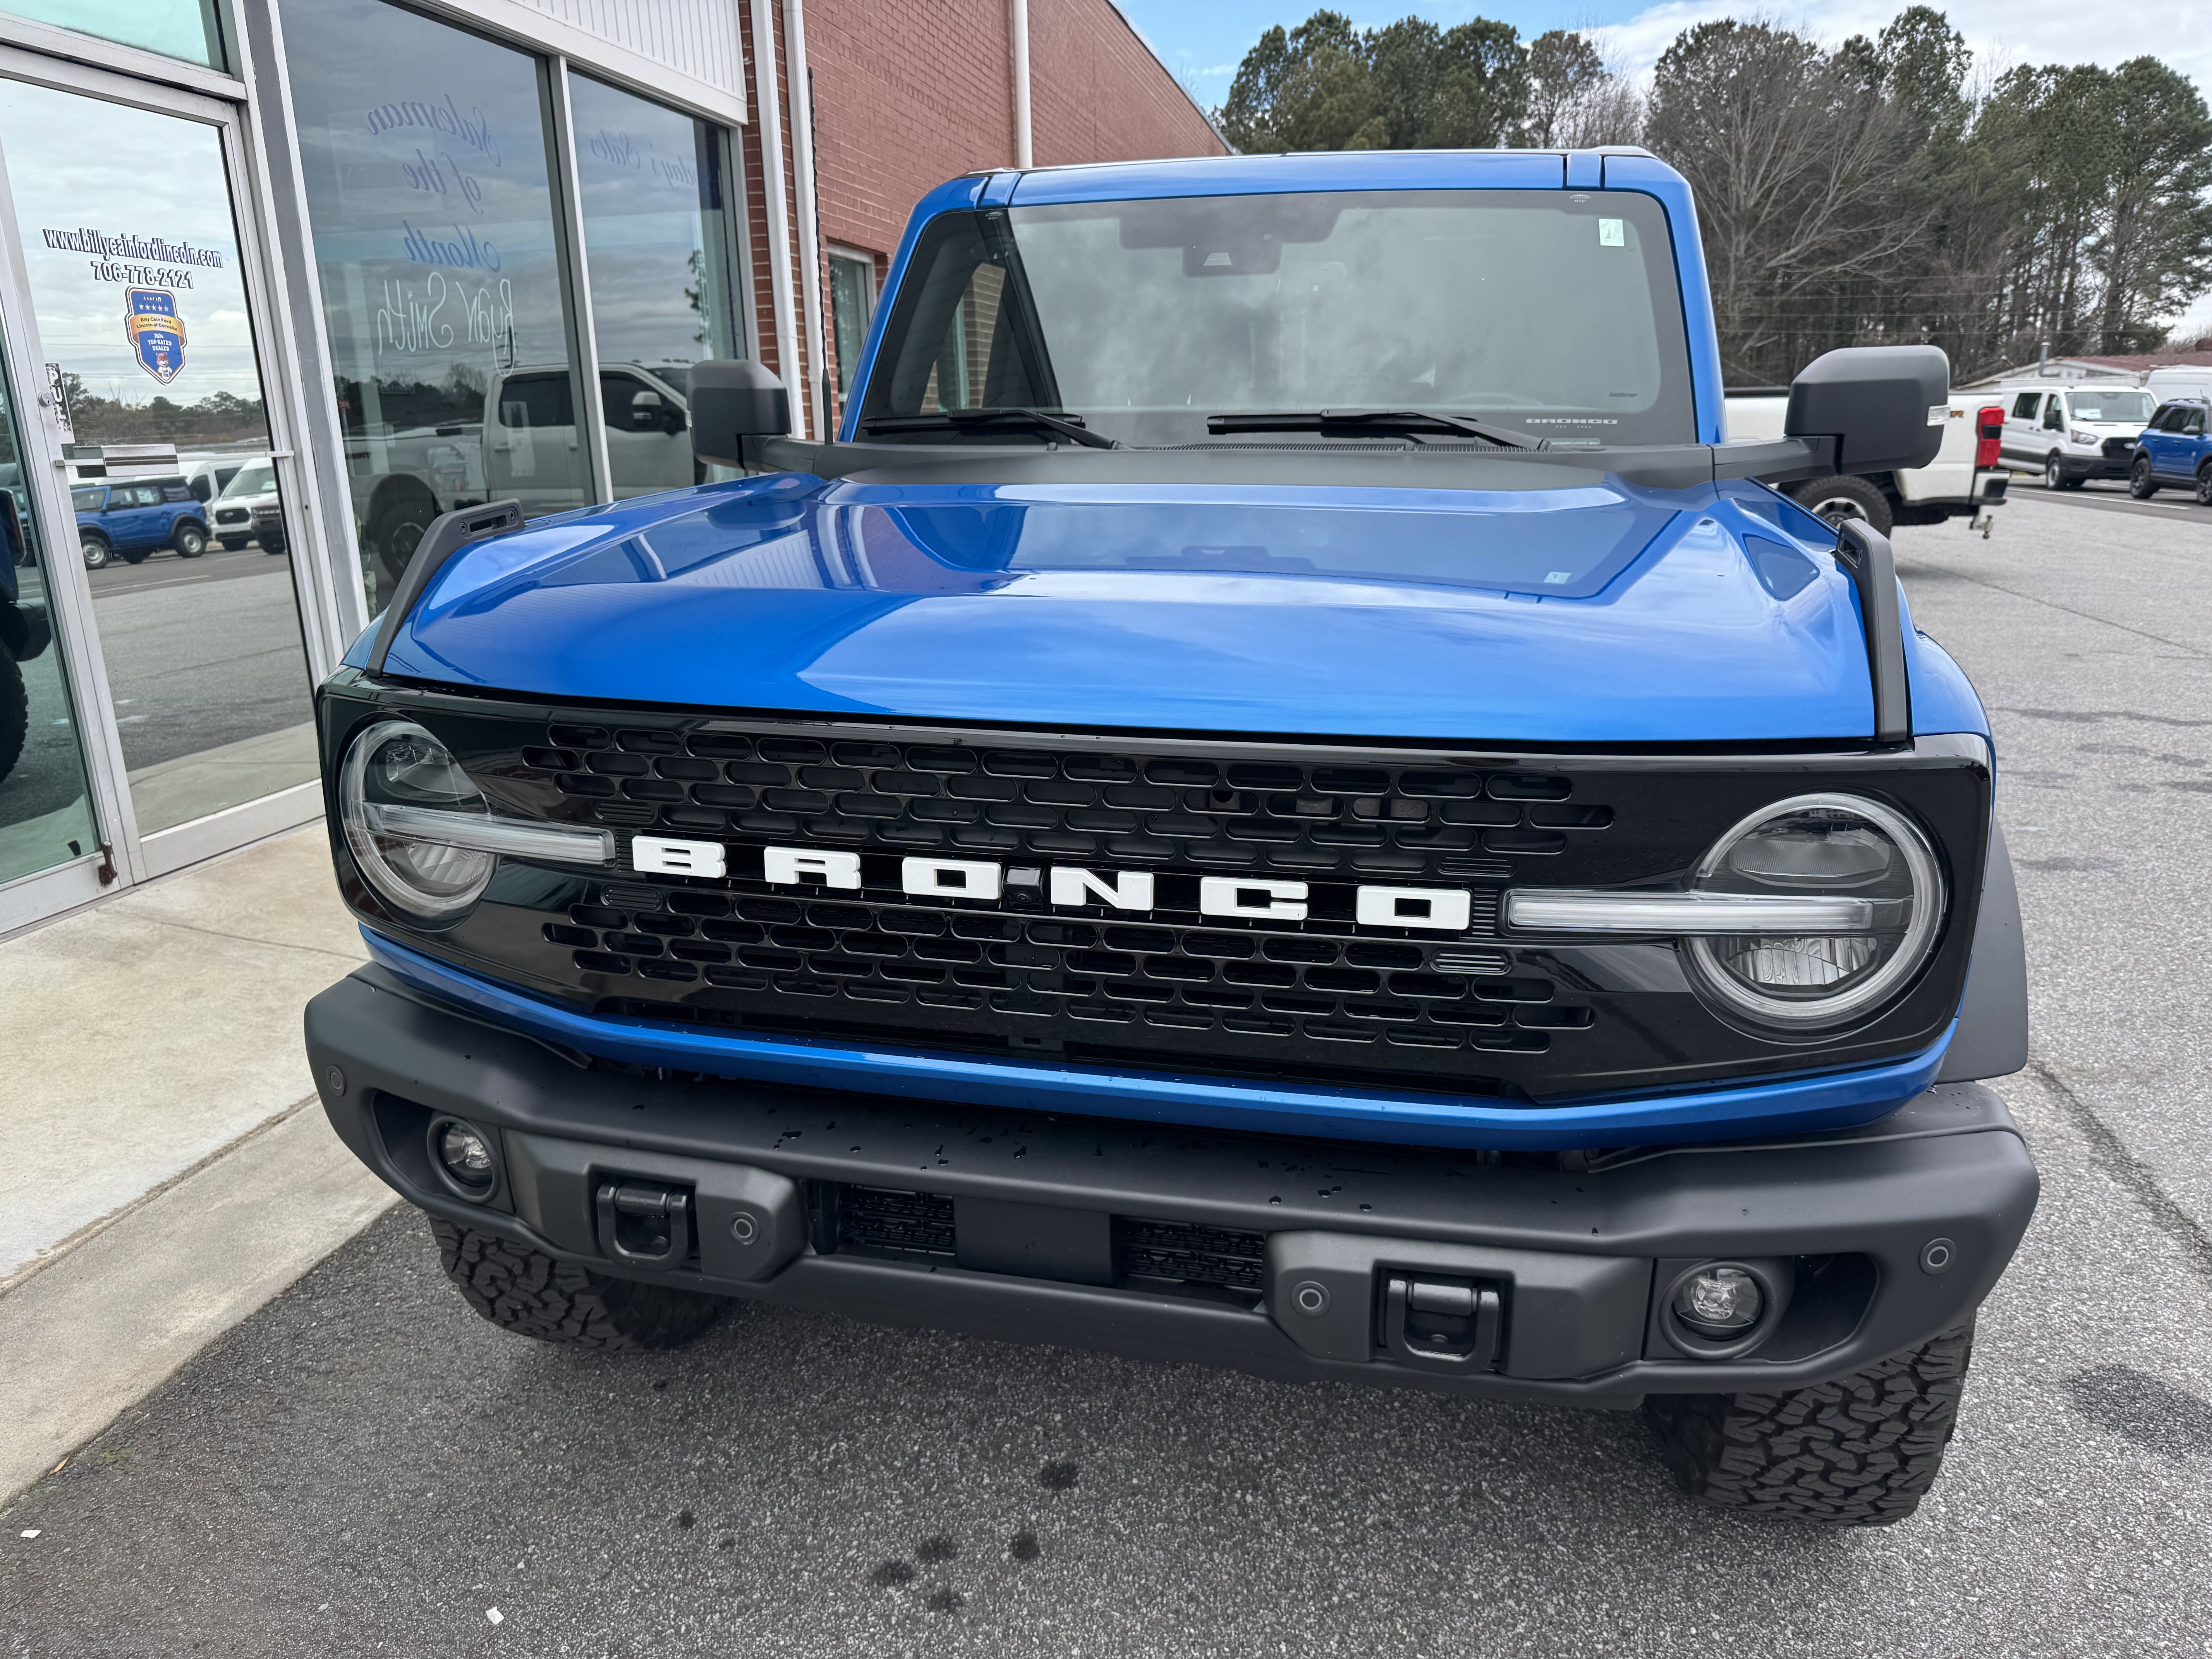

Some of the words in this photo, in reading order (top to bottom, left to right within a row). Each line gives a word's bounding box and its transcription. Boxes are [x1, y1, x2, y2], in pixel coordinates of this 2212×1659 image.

[43, 228, 223, 268] www.billycainfordlincoln.com
[91, 261, 194, 289] 706-778-2121
[632, 835, 1471, 930] BRONCO
